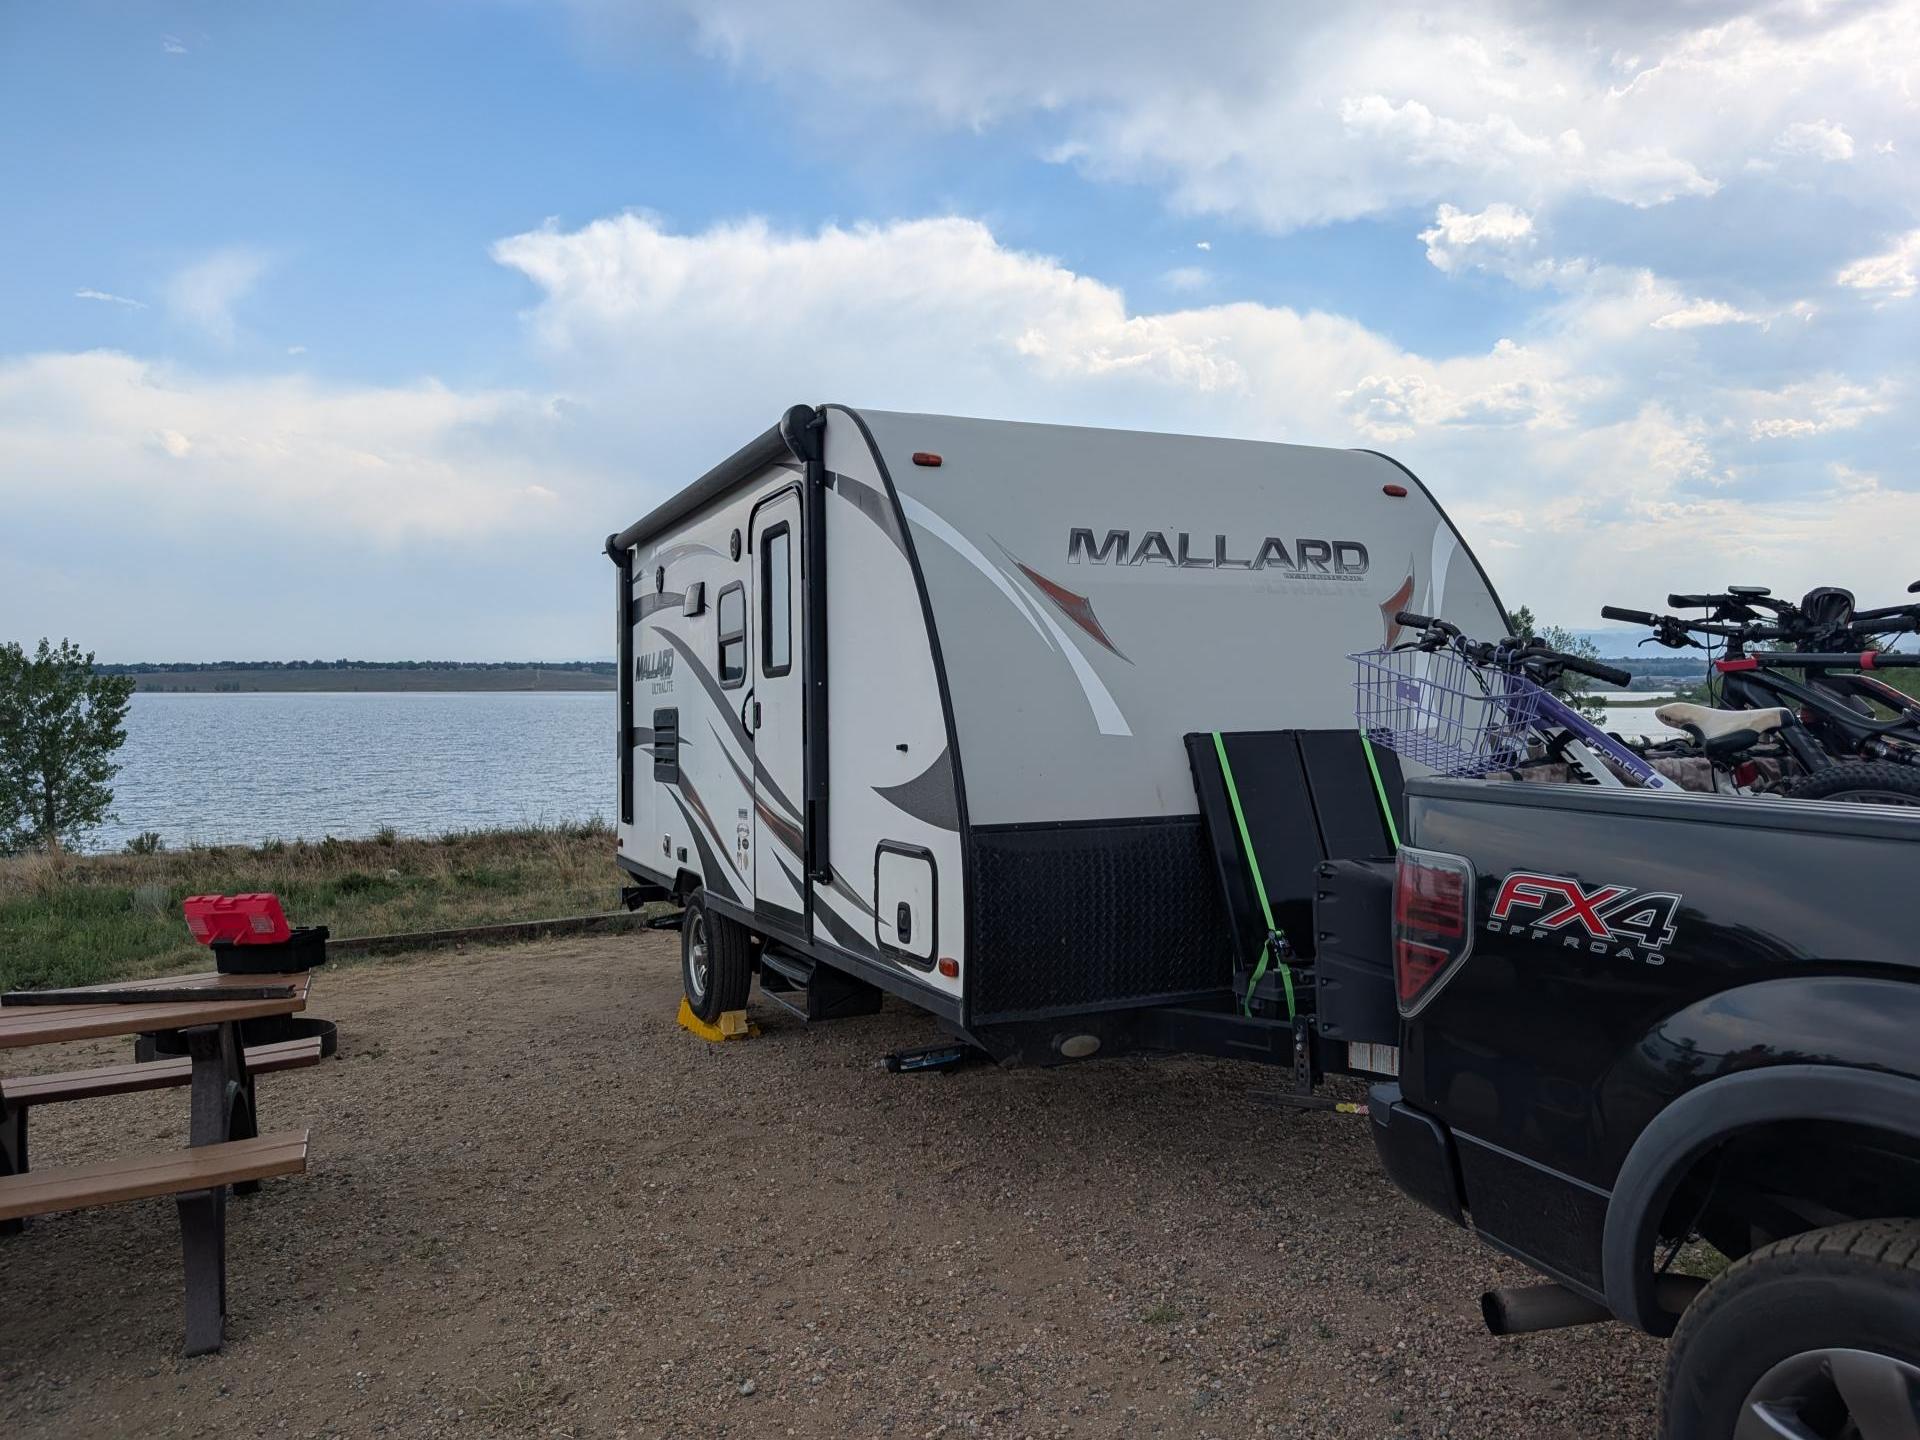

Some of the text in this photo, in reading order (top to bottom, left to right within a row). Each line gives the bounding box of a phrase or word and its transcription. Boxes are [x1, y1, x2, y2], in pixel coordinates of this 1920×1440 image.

[1067, 527, 1370, 575] MALLARD
[635, 648, 674, 682] MALLARD
[1490, 871, 1682, 950] FX4
[1487, 920, 1665, 966] OFF ROAD
